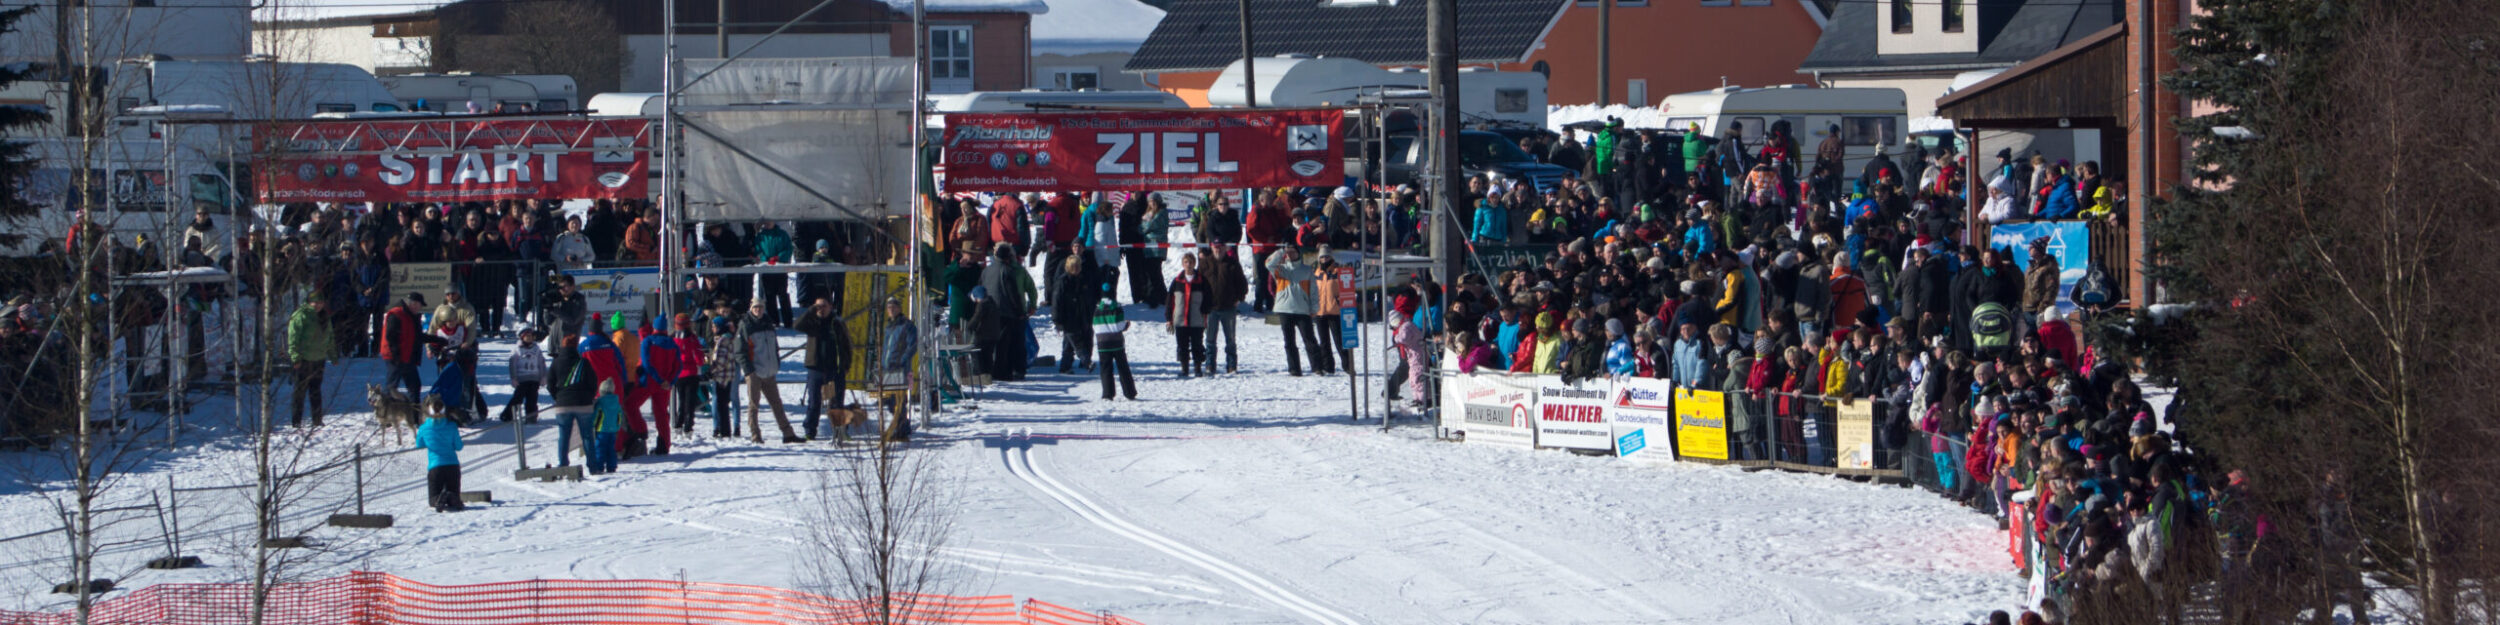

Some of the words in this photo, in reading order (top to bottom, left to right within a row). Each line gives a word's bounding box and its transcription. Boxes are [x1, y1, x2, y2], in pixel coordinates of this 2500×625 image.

[1095, 132, 1239, 174] ZIEL
[378, 144, 569, 185] START
[952, 176, 1058, 186] Auerbach-Rodewisch
[260, 189, 365, 198] Aerbach-Rodewisch
[1542, 386, 1560, 397] Snow
[1562, 388, 1598, 400] Equipment
[1598, 390, 1607, 400] by
[1631, 387, 1658, 401] Gütter
[1486, 408, 1504, 423] BAU
[1542, 403, 1603, 424] WALTHER
[1614, 412, 1664, 426] Dachdeckerfirma
